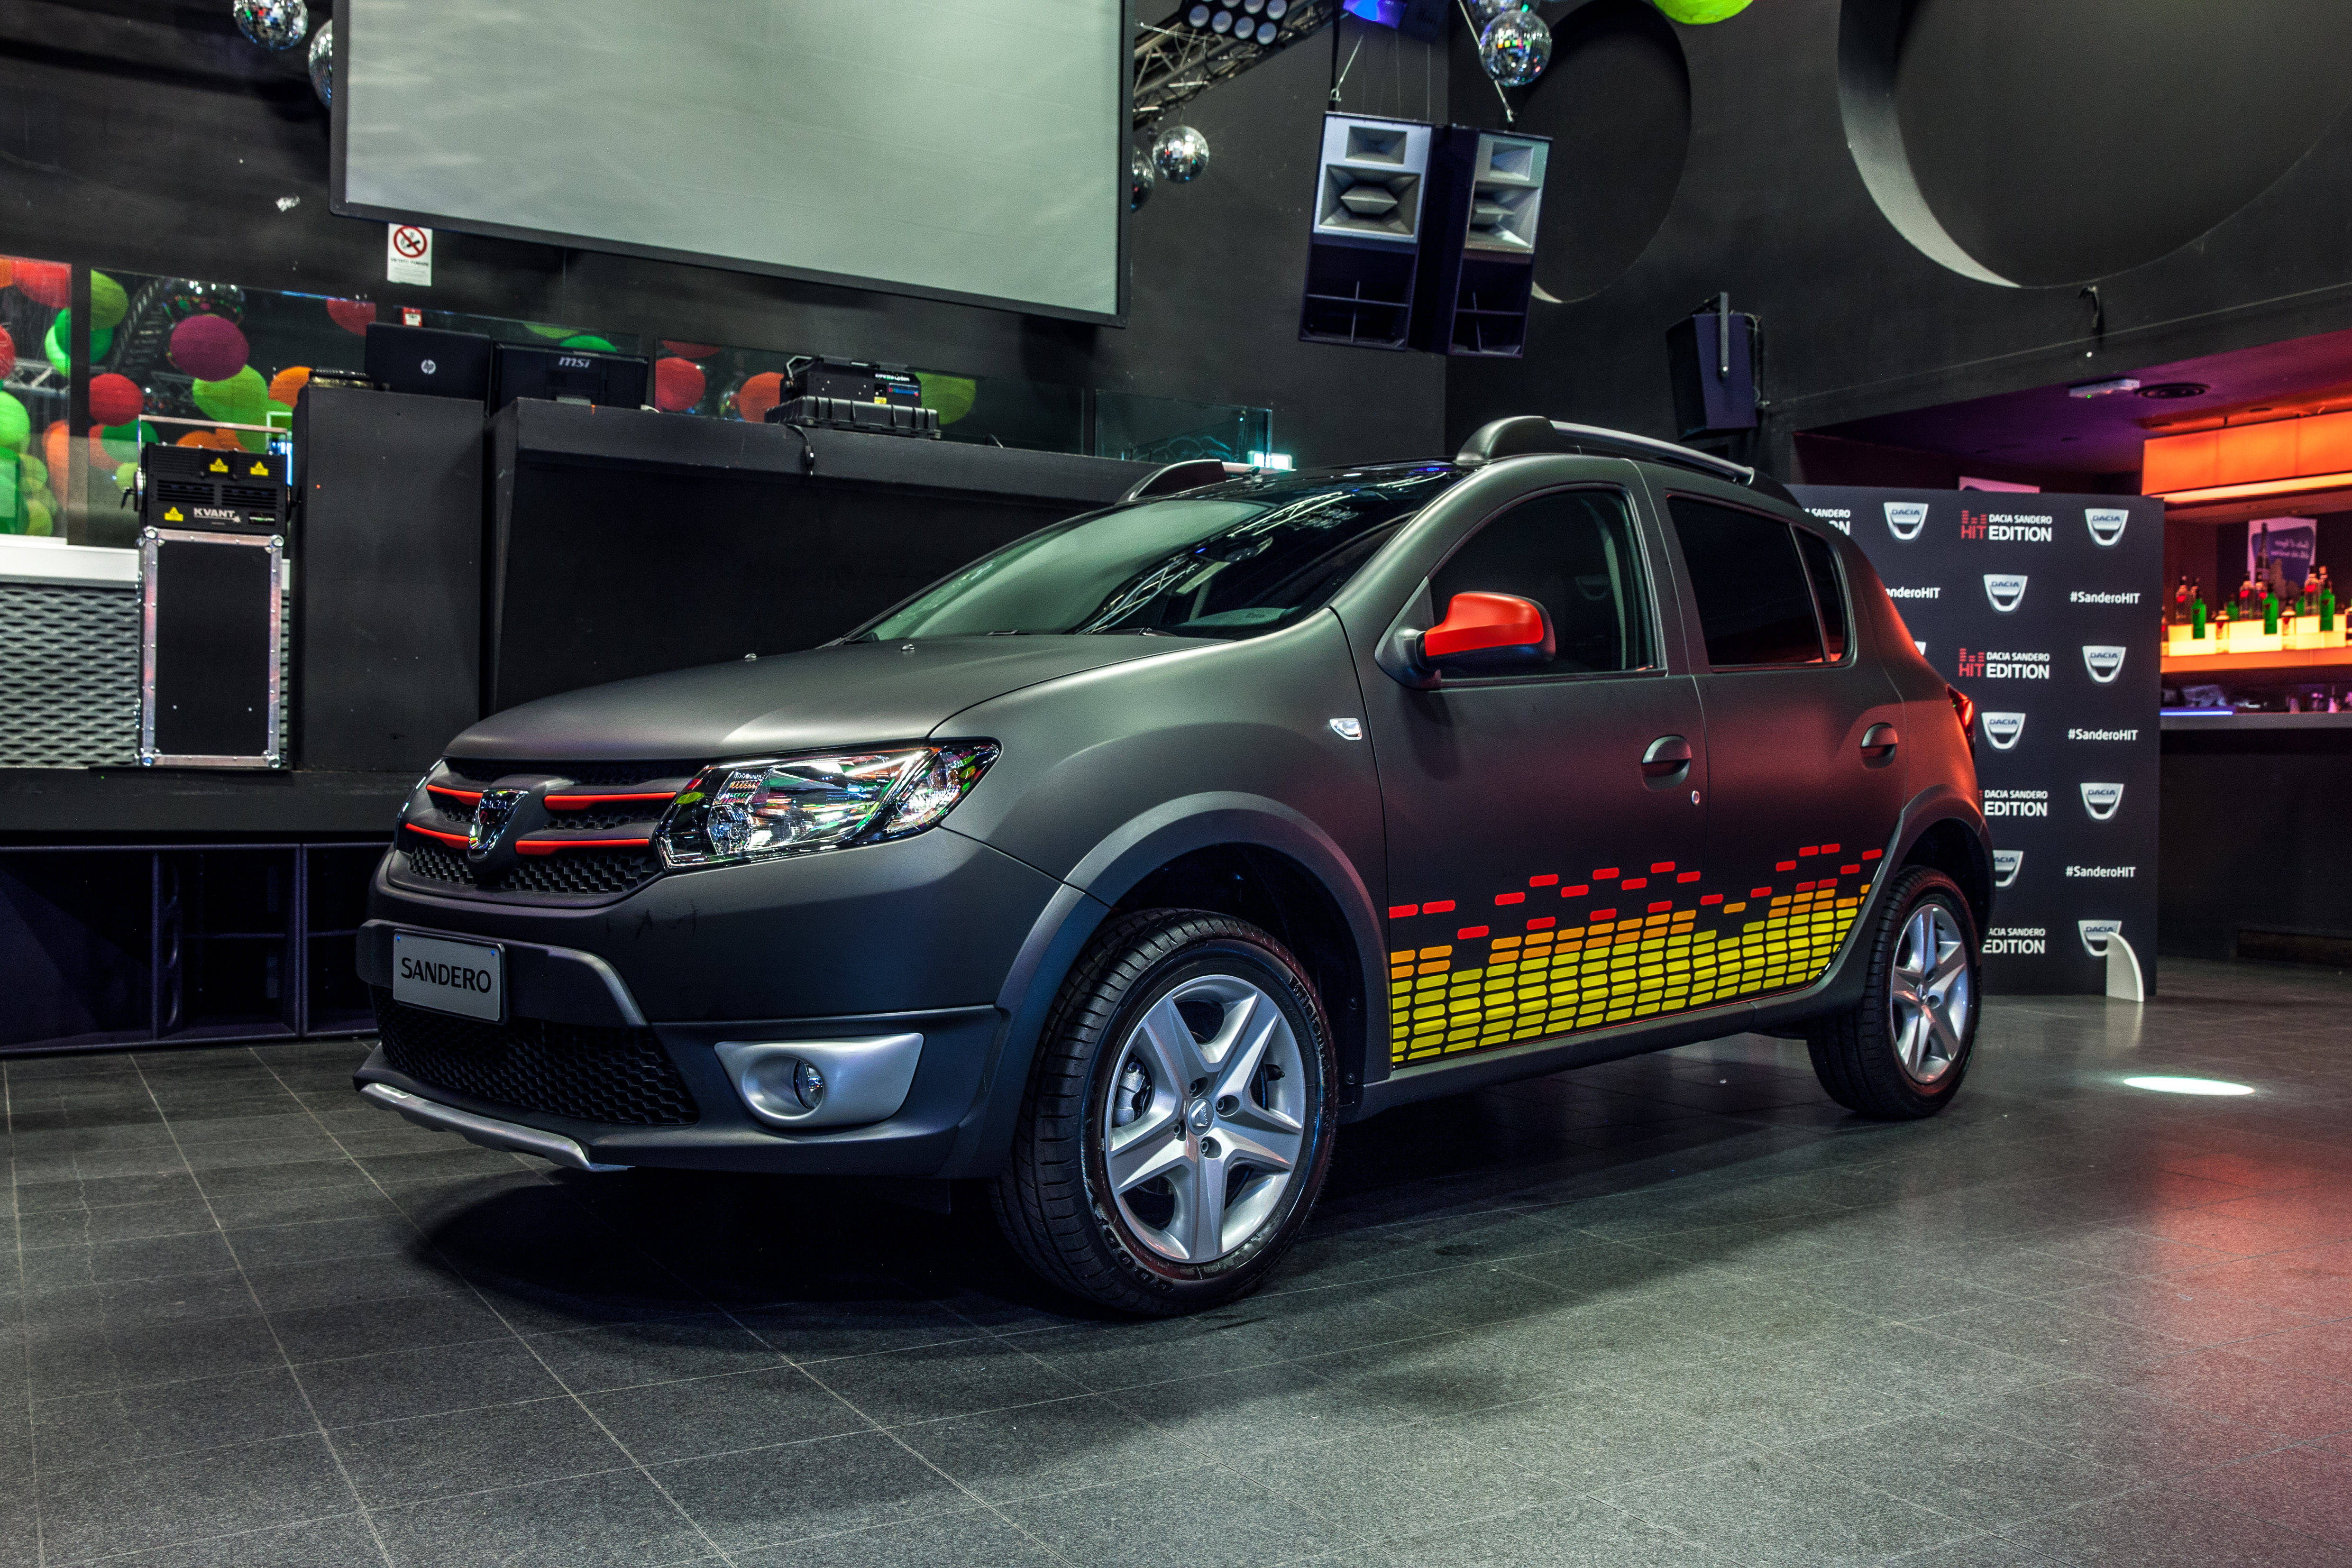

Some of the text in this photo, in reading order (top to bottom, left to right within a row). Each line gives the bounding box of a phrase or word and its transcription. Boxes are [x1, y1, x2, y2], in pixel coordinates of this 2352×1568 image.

[558, 356, 591, 369] msi
[193, 507, 236, 518] KVANT
[1989, 513, 2052, 525] DACIA SANDERO
[1961, 525, 2052, 542] HIT EDITION
[1885, 587, 1940, 599] anderoHIT
[2070, 591, 2141, 604] #SanderoHIT
[1986, 651, 2050, 662] DACIA SANDERO
[1958, 663, 2050, 679] HIT EDITION
[2068, 728, 2139, 741] #SanderoHIT
[1984, 789, 2048, 799] DACIA SANDERO
[1984, 801, 2048, 817] EDITION
[2065, 865, 2136, 878] #SanderoHIT
[1989, 927, 2046, 937] ACIA SANDERO
[1982, 939, 2046, 954] EDITION
[401, 956, 492, 994] SANDERO
